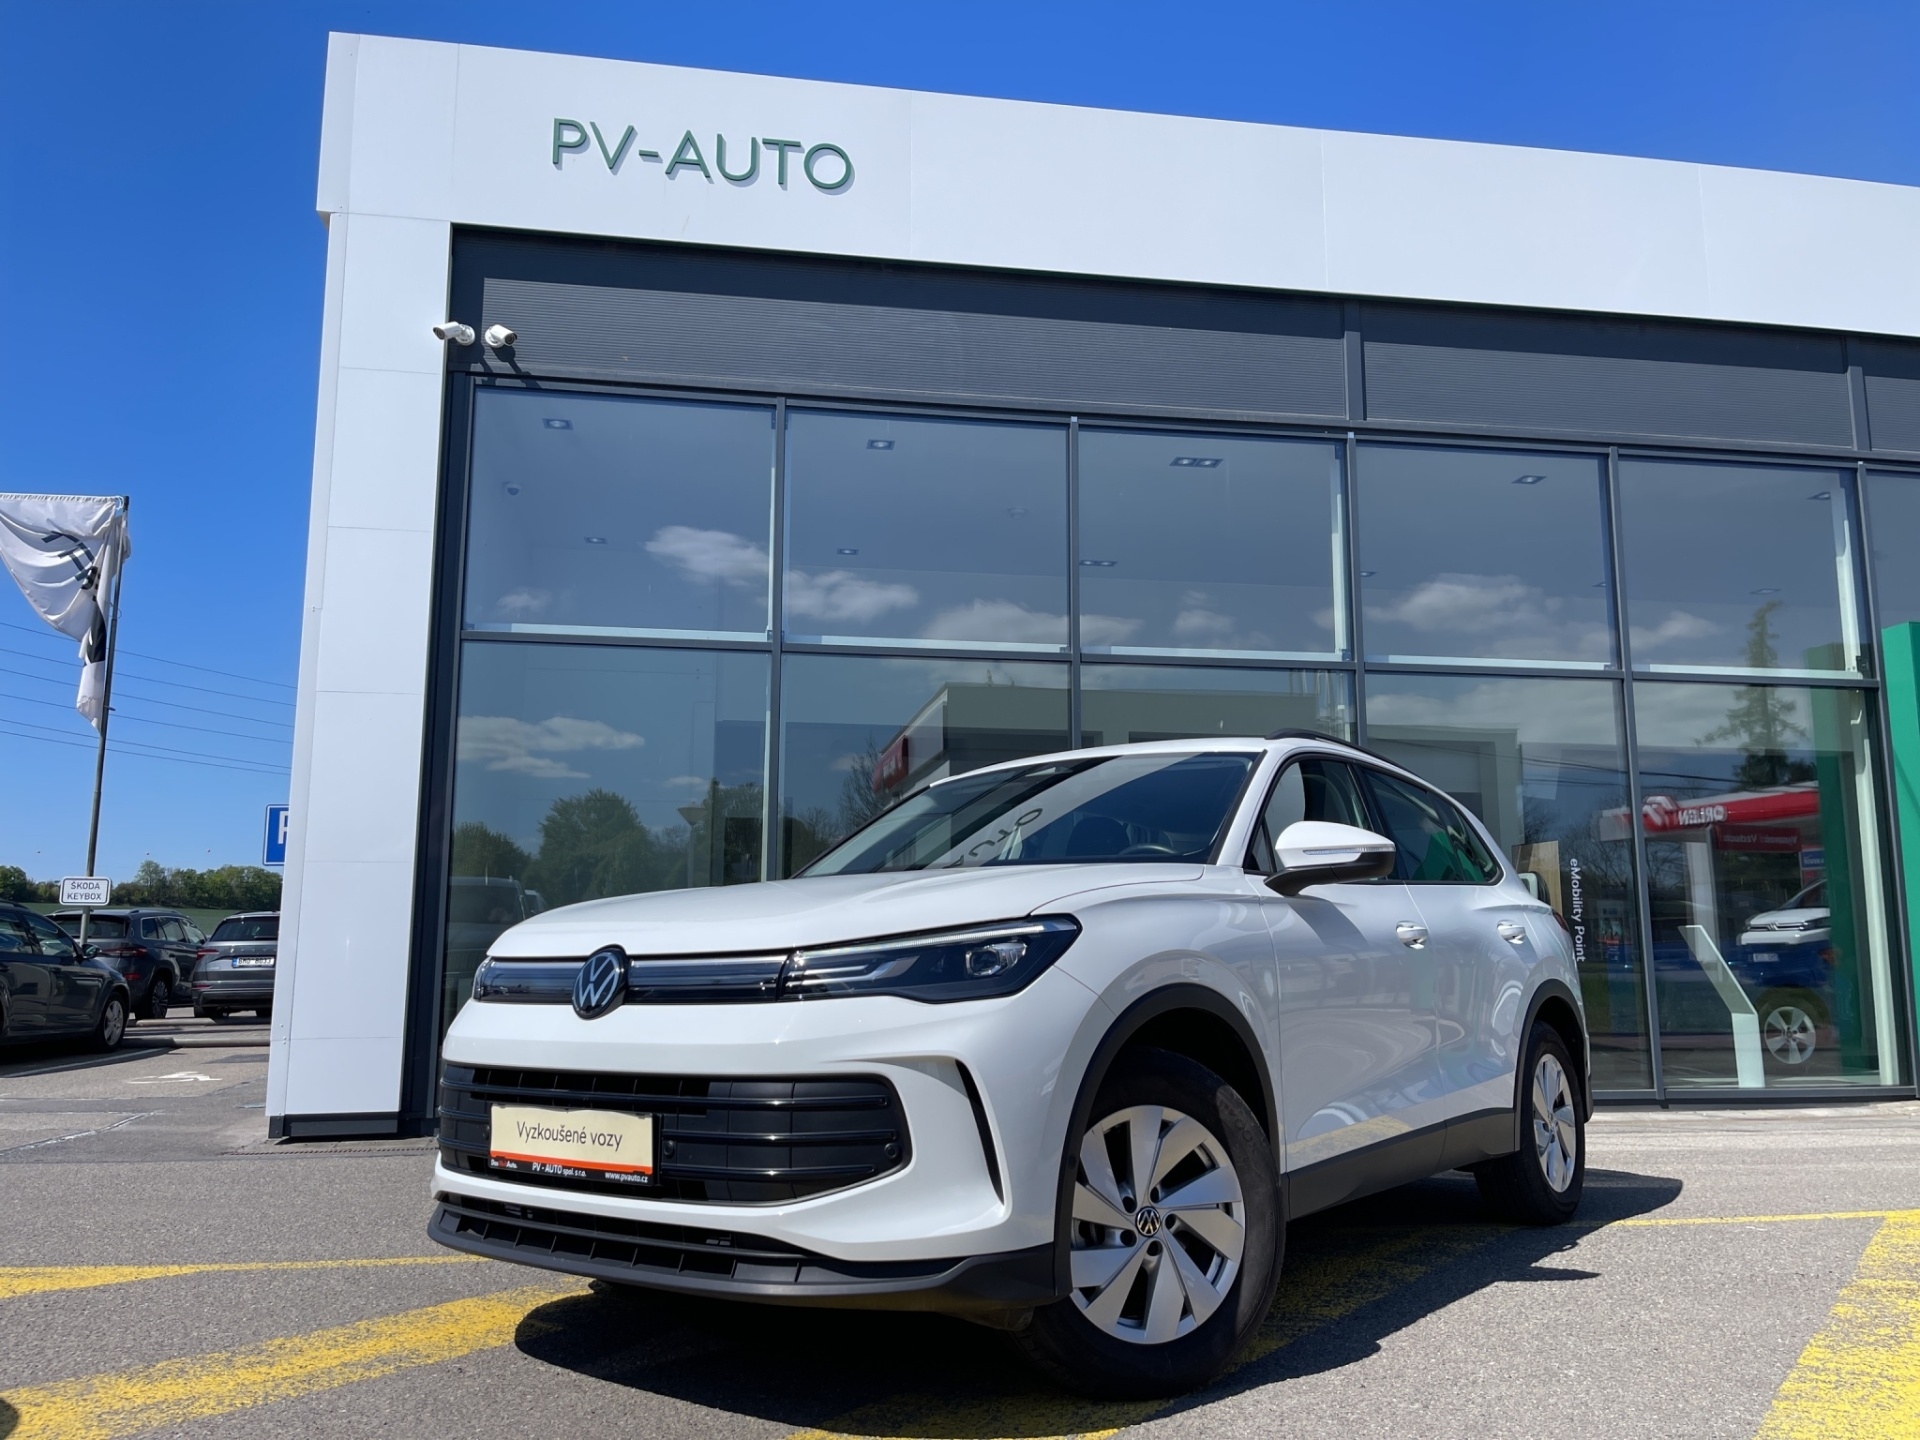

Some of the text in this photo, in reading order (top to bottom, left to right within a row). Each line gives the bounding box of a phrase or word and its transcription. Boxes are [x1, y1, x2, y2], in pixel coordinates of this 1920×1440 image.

[552, 118, 852, 191] PV-AUTO
[70, 881, 100, 890] ŠKODA
[67, 892, 102, 900] KEYBOX
[1570, 858, 1586, 962] eMobility Point
[517, 1120, 623, 1152] Vyzkoušené vozy
[532, 1162, 541, 1172] PV
[545, 1164, 562, 1174] AUTO
[605, 1172, 648, 1183] www.pvauto.cz
